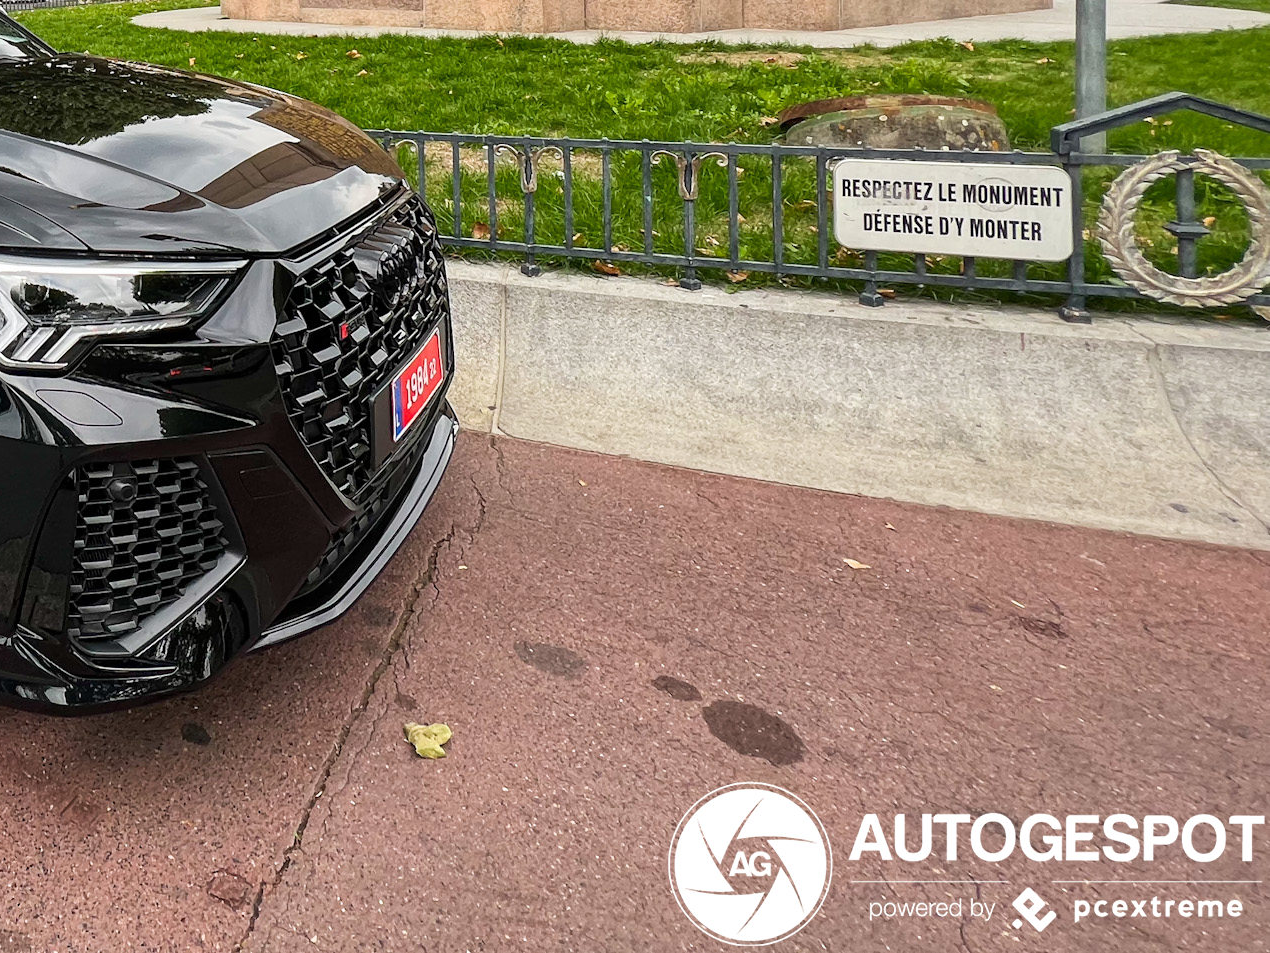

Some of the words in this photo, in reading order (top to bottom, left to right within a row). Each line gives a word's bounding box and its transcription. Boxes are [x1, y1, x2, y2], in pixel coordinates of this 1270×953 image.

[842, 179, 933, 202] RESPECTEZ
[939, 183, 957, 202] LE
[963, 184, 1063, 207] MONUMENT
[863, 209, 934, 235] DÉFENSE
[939, 217, 964, 236] D'Y
[970, 219, 1042, 241] MONTER
[406, 358, 428, 409] 1984
[429, 358, 437, 379] 22
